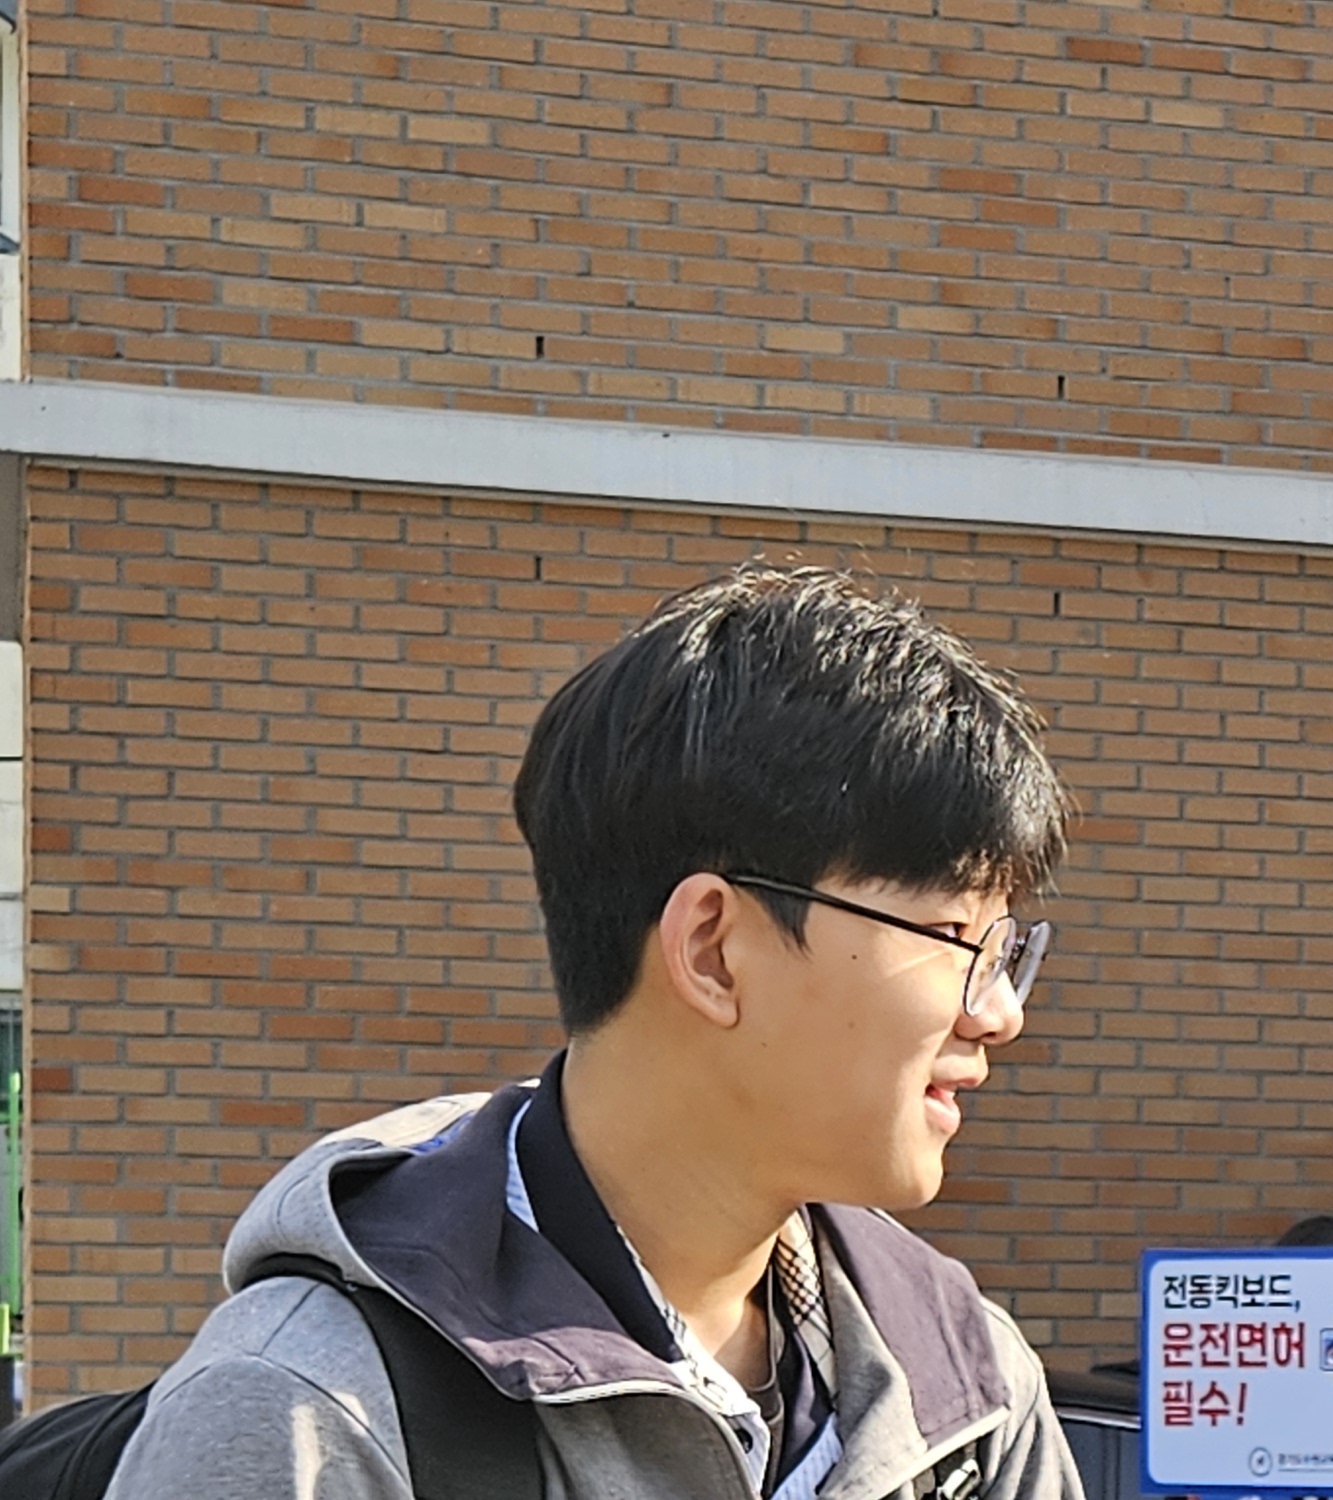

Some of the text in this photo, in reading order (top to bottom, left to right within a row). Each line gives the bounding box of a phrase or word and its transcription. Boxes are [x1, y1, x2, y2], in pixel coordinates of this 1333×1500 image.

[1163, 1274, 1301, 1313] 전동킥보드,
[1162, 1321, 1306, 1369] 운전면허
[1162, 1379, 1248, 1428] 필수!
